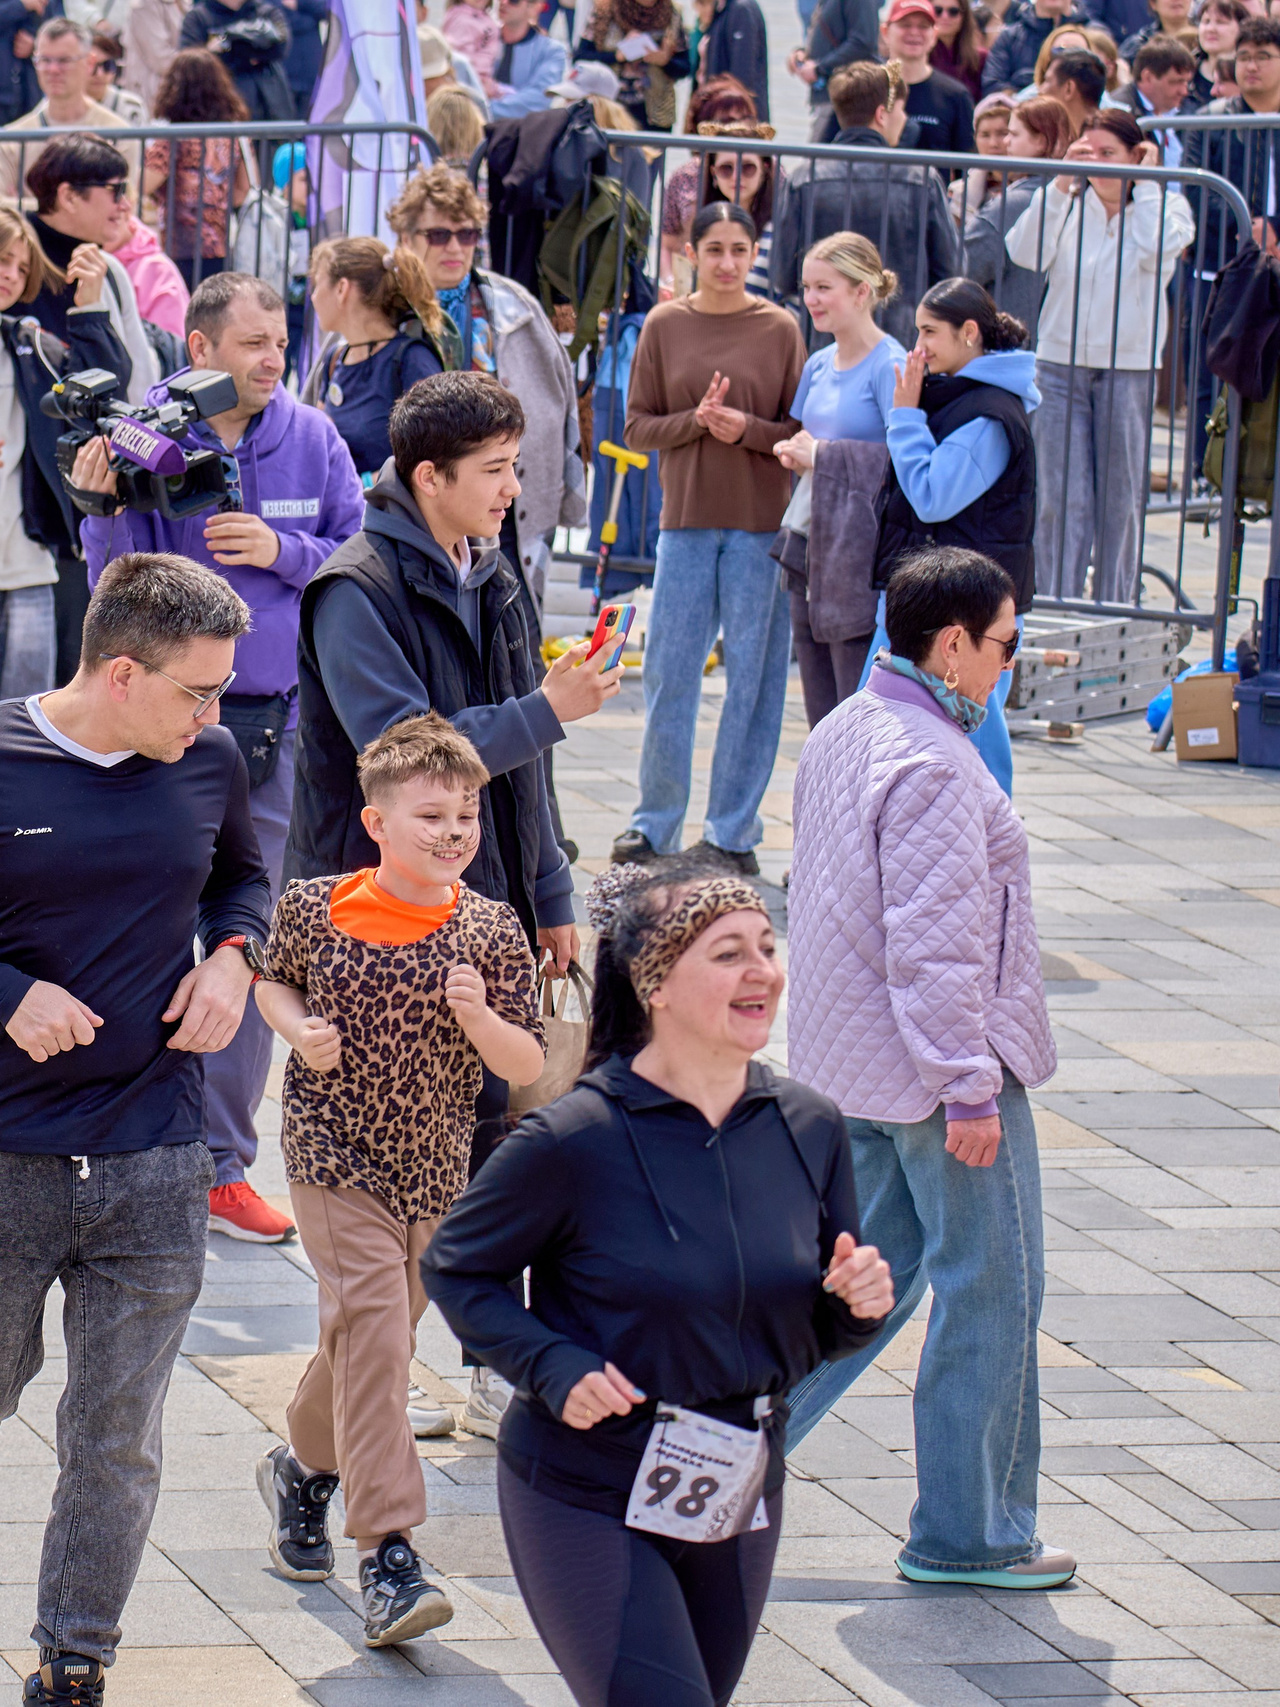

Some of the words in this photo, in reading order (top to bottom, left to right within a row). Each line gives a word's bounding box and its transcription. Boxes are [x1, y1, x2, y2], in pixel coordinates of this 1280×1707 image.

[110, 421, 160, 461] ИЗВЕСТИЯ
[645, 1465, 720, 1518] 98
[64, 1664, 90, 1675] PUMA
